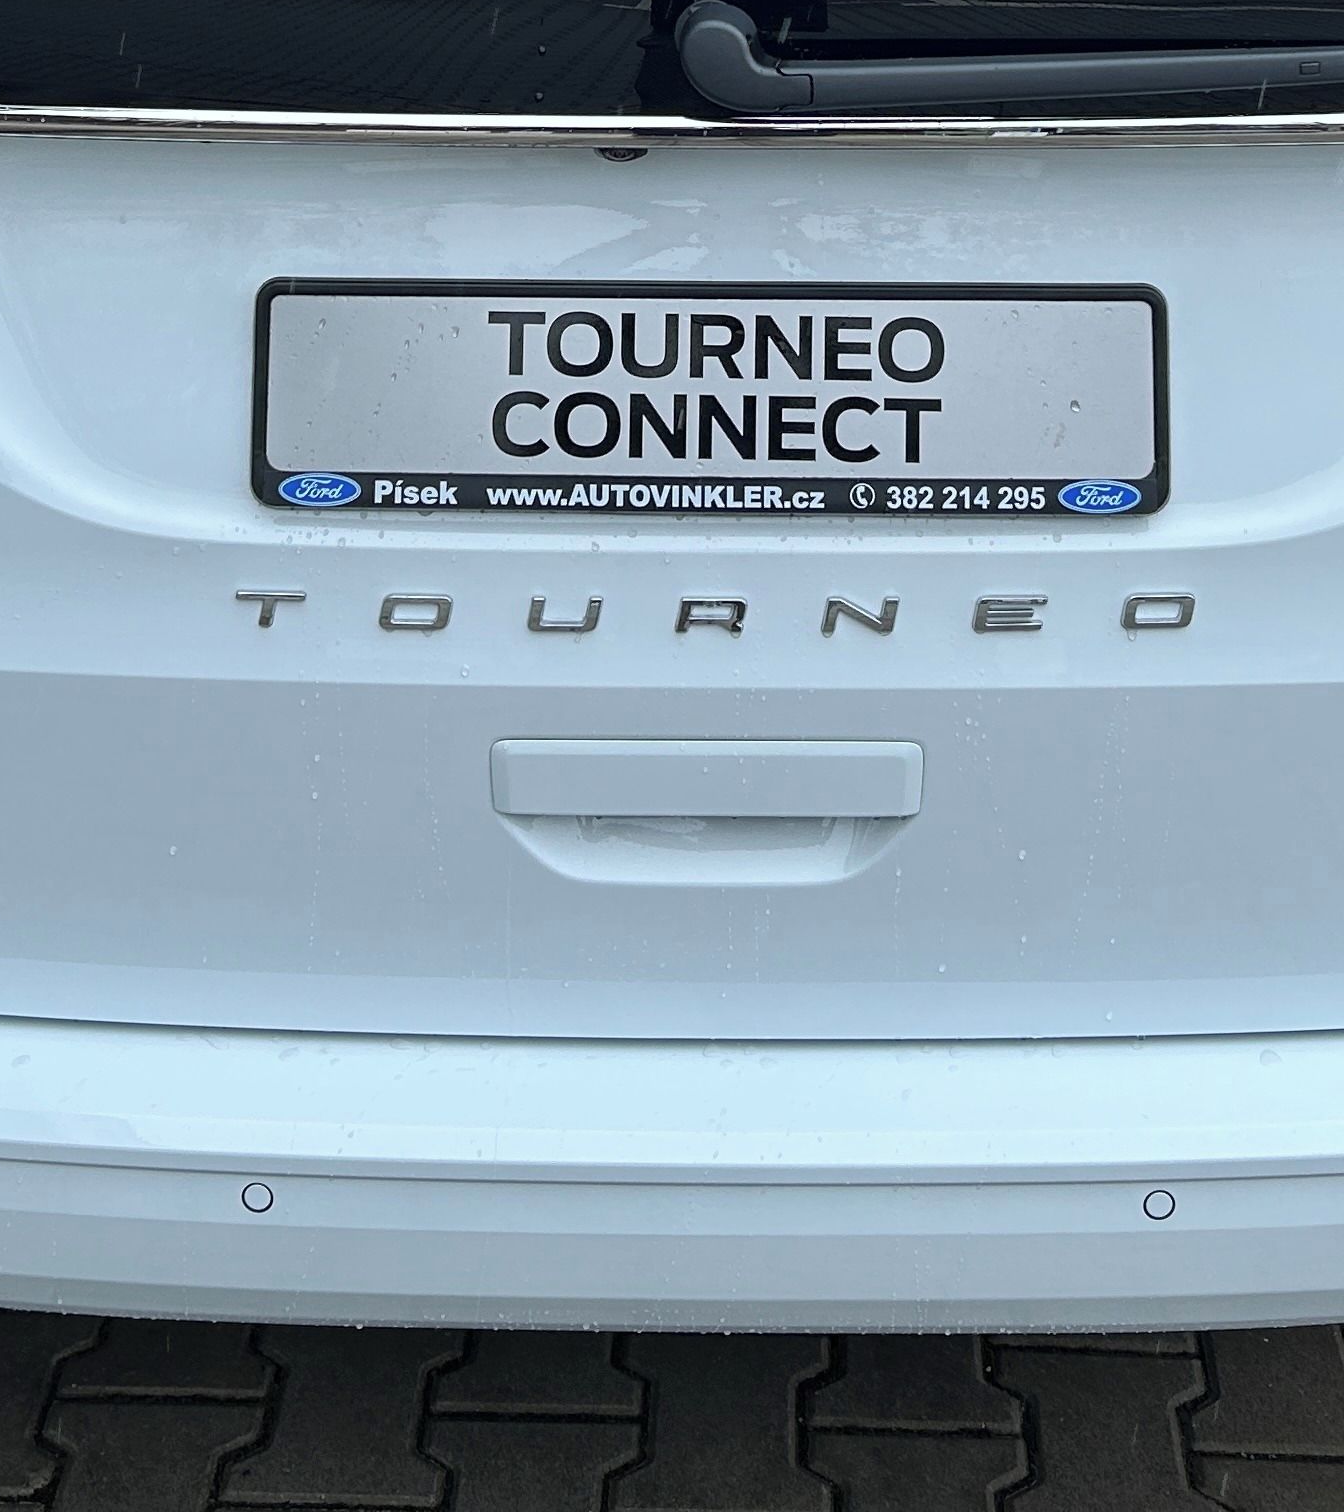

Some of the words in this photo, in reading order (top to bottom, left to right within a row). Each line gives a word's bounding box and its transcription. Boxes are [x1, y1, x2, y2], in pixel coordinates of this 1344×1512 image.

[488, 311, 945, 383] TOURNEO
[492, 390, 942, 464] CONNECT
[373, 479, 458, 506] Písek
[486, 483, 825, 509] www.AUTOVINKLER.cz
[886, 486, 934, 510] 382
[941, 486, 990, 510] 214
[997, 486, 1046, 510] 295
[235, 590, 1196, 635] TOURNEO
